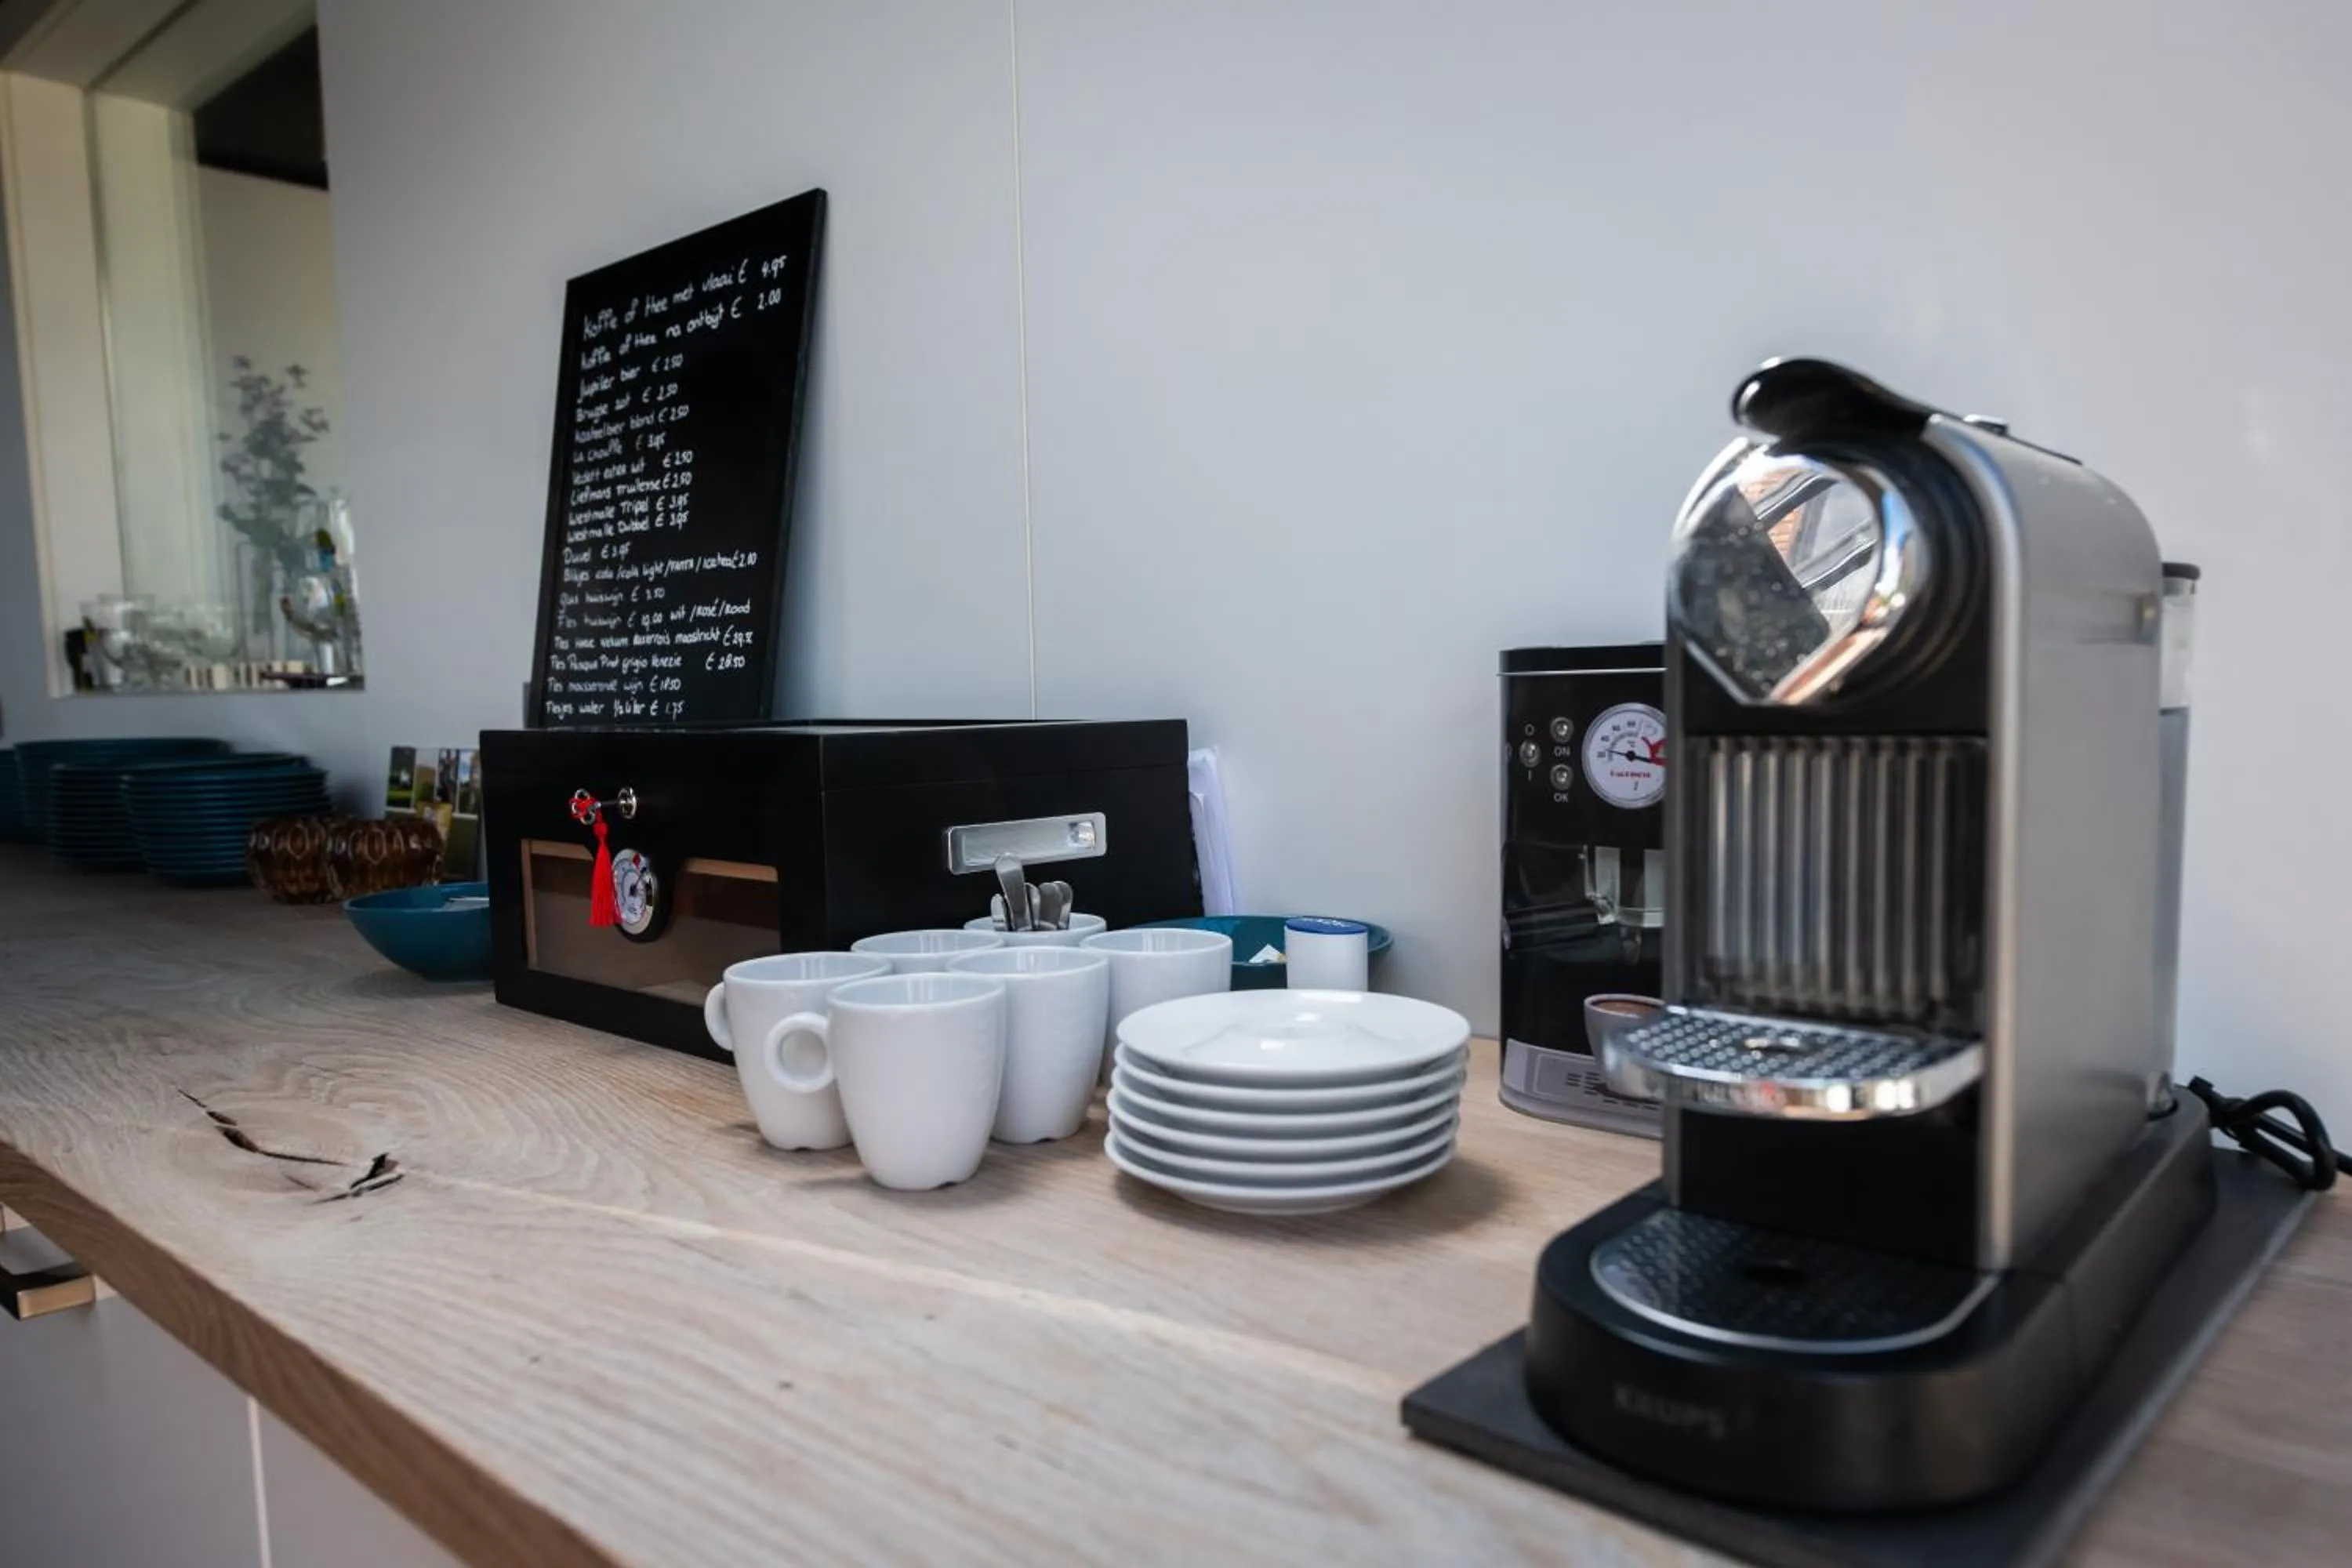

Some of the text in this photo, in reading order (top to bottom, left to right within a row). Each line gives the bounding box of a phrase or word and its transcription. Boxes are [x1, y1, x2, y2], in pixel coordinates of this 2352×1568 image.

[624, 297, 639, 325] of
[644, 296, 668, 317] thee
[673, 284, 695, 303] met
[702, 266, 735, 292] vlaai
[737, 258, 749, 285] €
[761, 255, 787, 279] 4.95
[618, 333, 633, 356] of
[633, 332, 657, 347] thee
[665, 324, 682, 338] na
[686, 303, 725, 333] ontbijt
[730, 296, 742, 319] €
[757, 288, 782, 310] 2.00
[620, 366, 641, 382] bier
[651, 357, 661, 373] €
[641, 386, 652, 404] €
[657, 406, 669, 423] €
[634, 434, 644, 452] €
[662, 452, 672, 469] €
[662, 471, 672, 490] €
[655, 495, 666, 512] €
[654, 510, 665, 528] €
[600, 543, 609, 560] €
[630, 585, 641, 603] €
[626, 610, 637, 628] €
[670, 604, 686, 621] wit
[722, 624, 733, 647] €
[705, 652, 719, 671] €
[717, 652, 746, 670] 28.50
[648, 673, 659, 693] €
[649, 699, 659, 717] €
[1554, 746, 1570, 757] ON
[1554, 793, 1568, 804] OK
